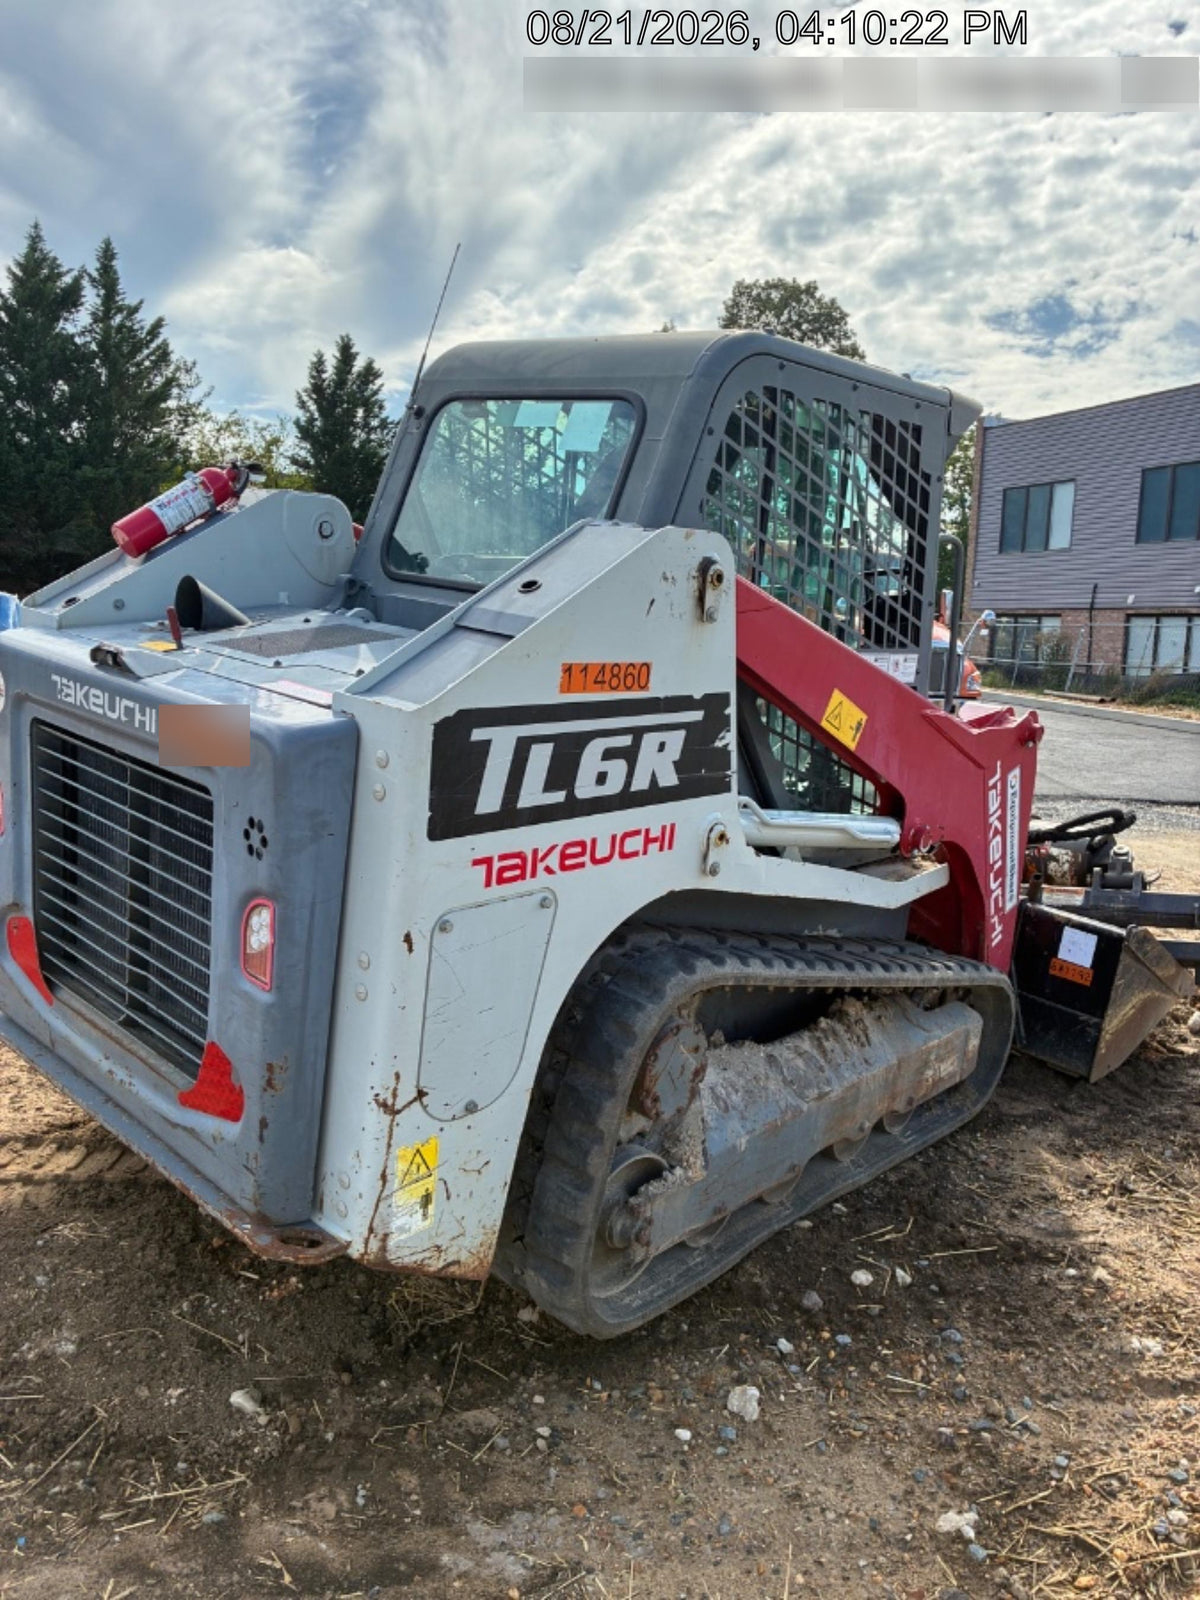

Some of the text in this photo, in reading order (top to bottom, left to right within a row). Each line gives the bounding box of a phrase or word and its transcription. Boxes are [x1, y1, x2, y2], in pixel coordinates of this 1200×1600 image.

[51, 673, 156, 734] TAKEUCHI
[562, 662, 650, 691] 114860
[469, 710, 704, 815] TL6R
[471, 823, 676, 888] TAKEUCHI
[988, 760, 1003, 947] TAKEUCHI
